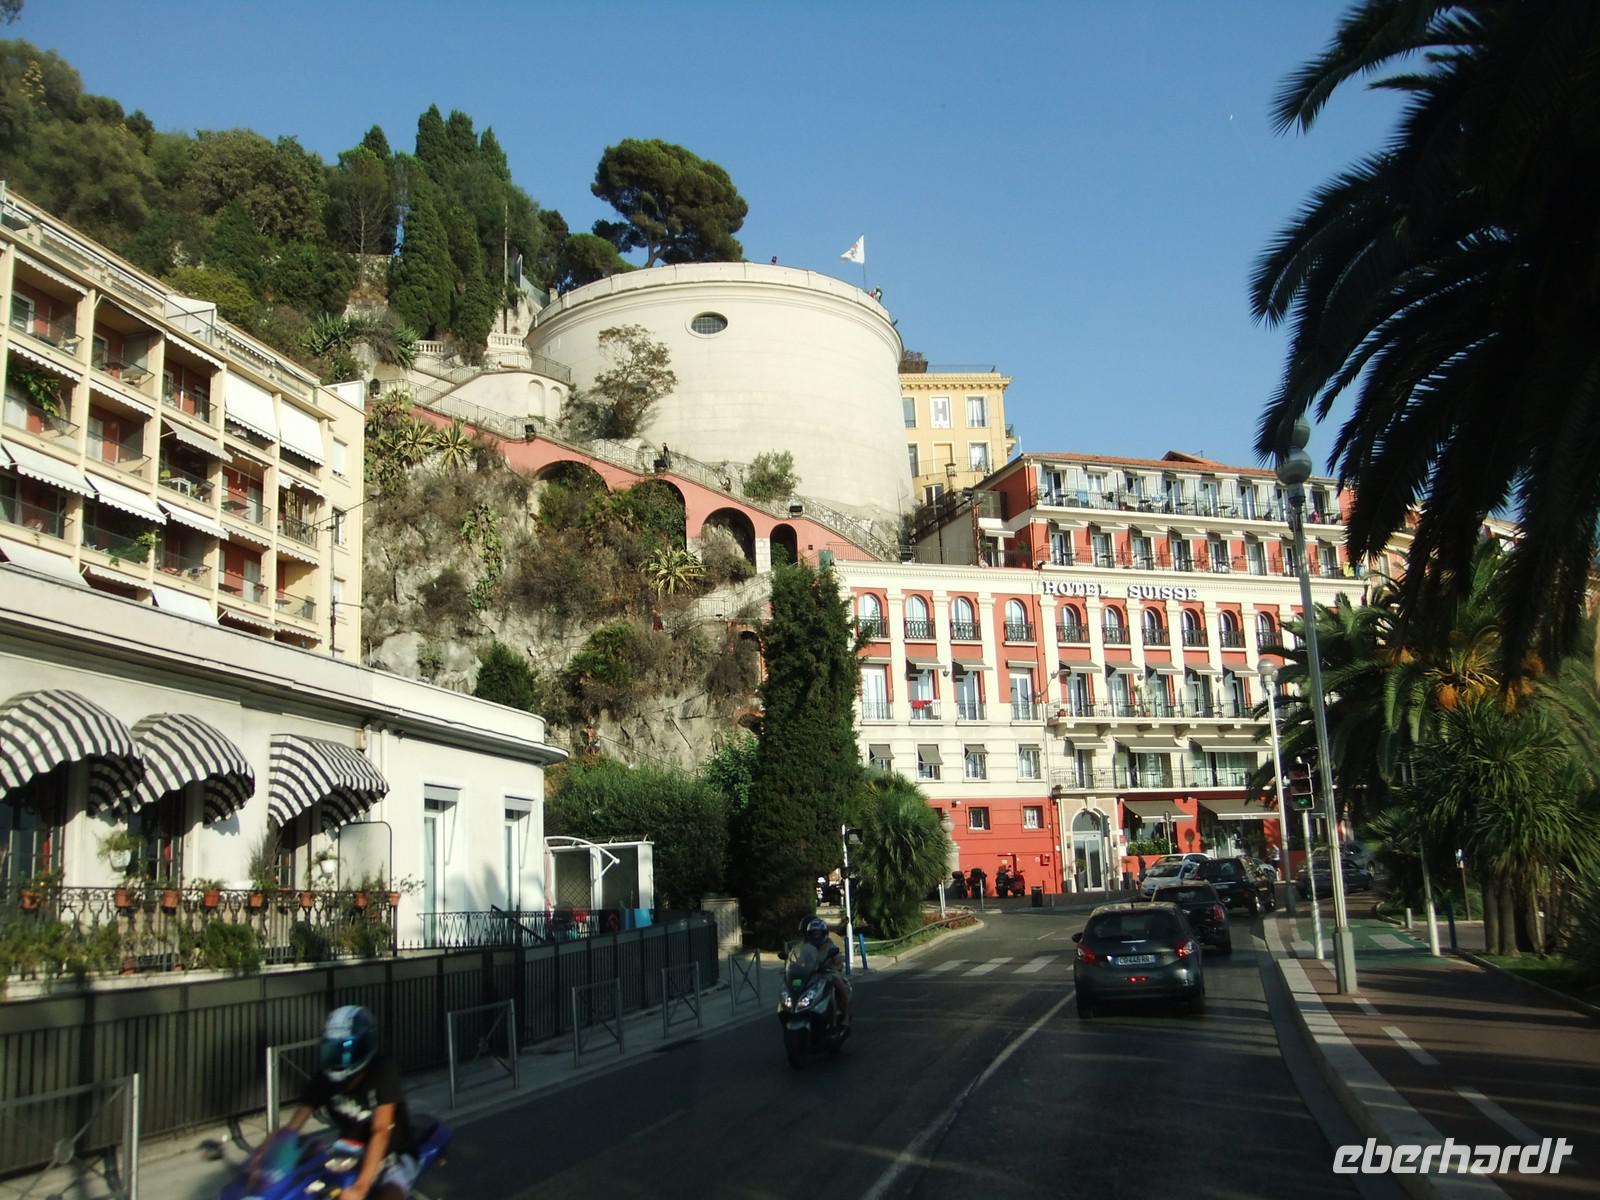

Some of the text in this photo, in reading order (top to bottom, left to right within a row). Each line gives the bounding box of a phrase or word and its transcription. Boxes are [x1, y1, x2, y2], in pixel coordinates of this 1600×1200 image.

[933, 400, 948, 421] H
[1043, 581, 1199, 600] HOTEL SUISSE
